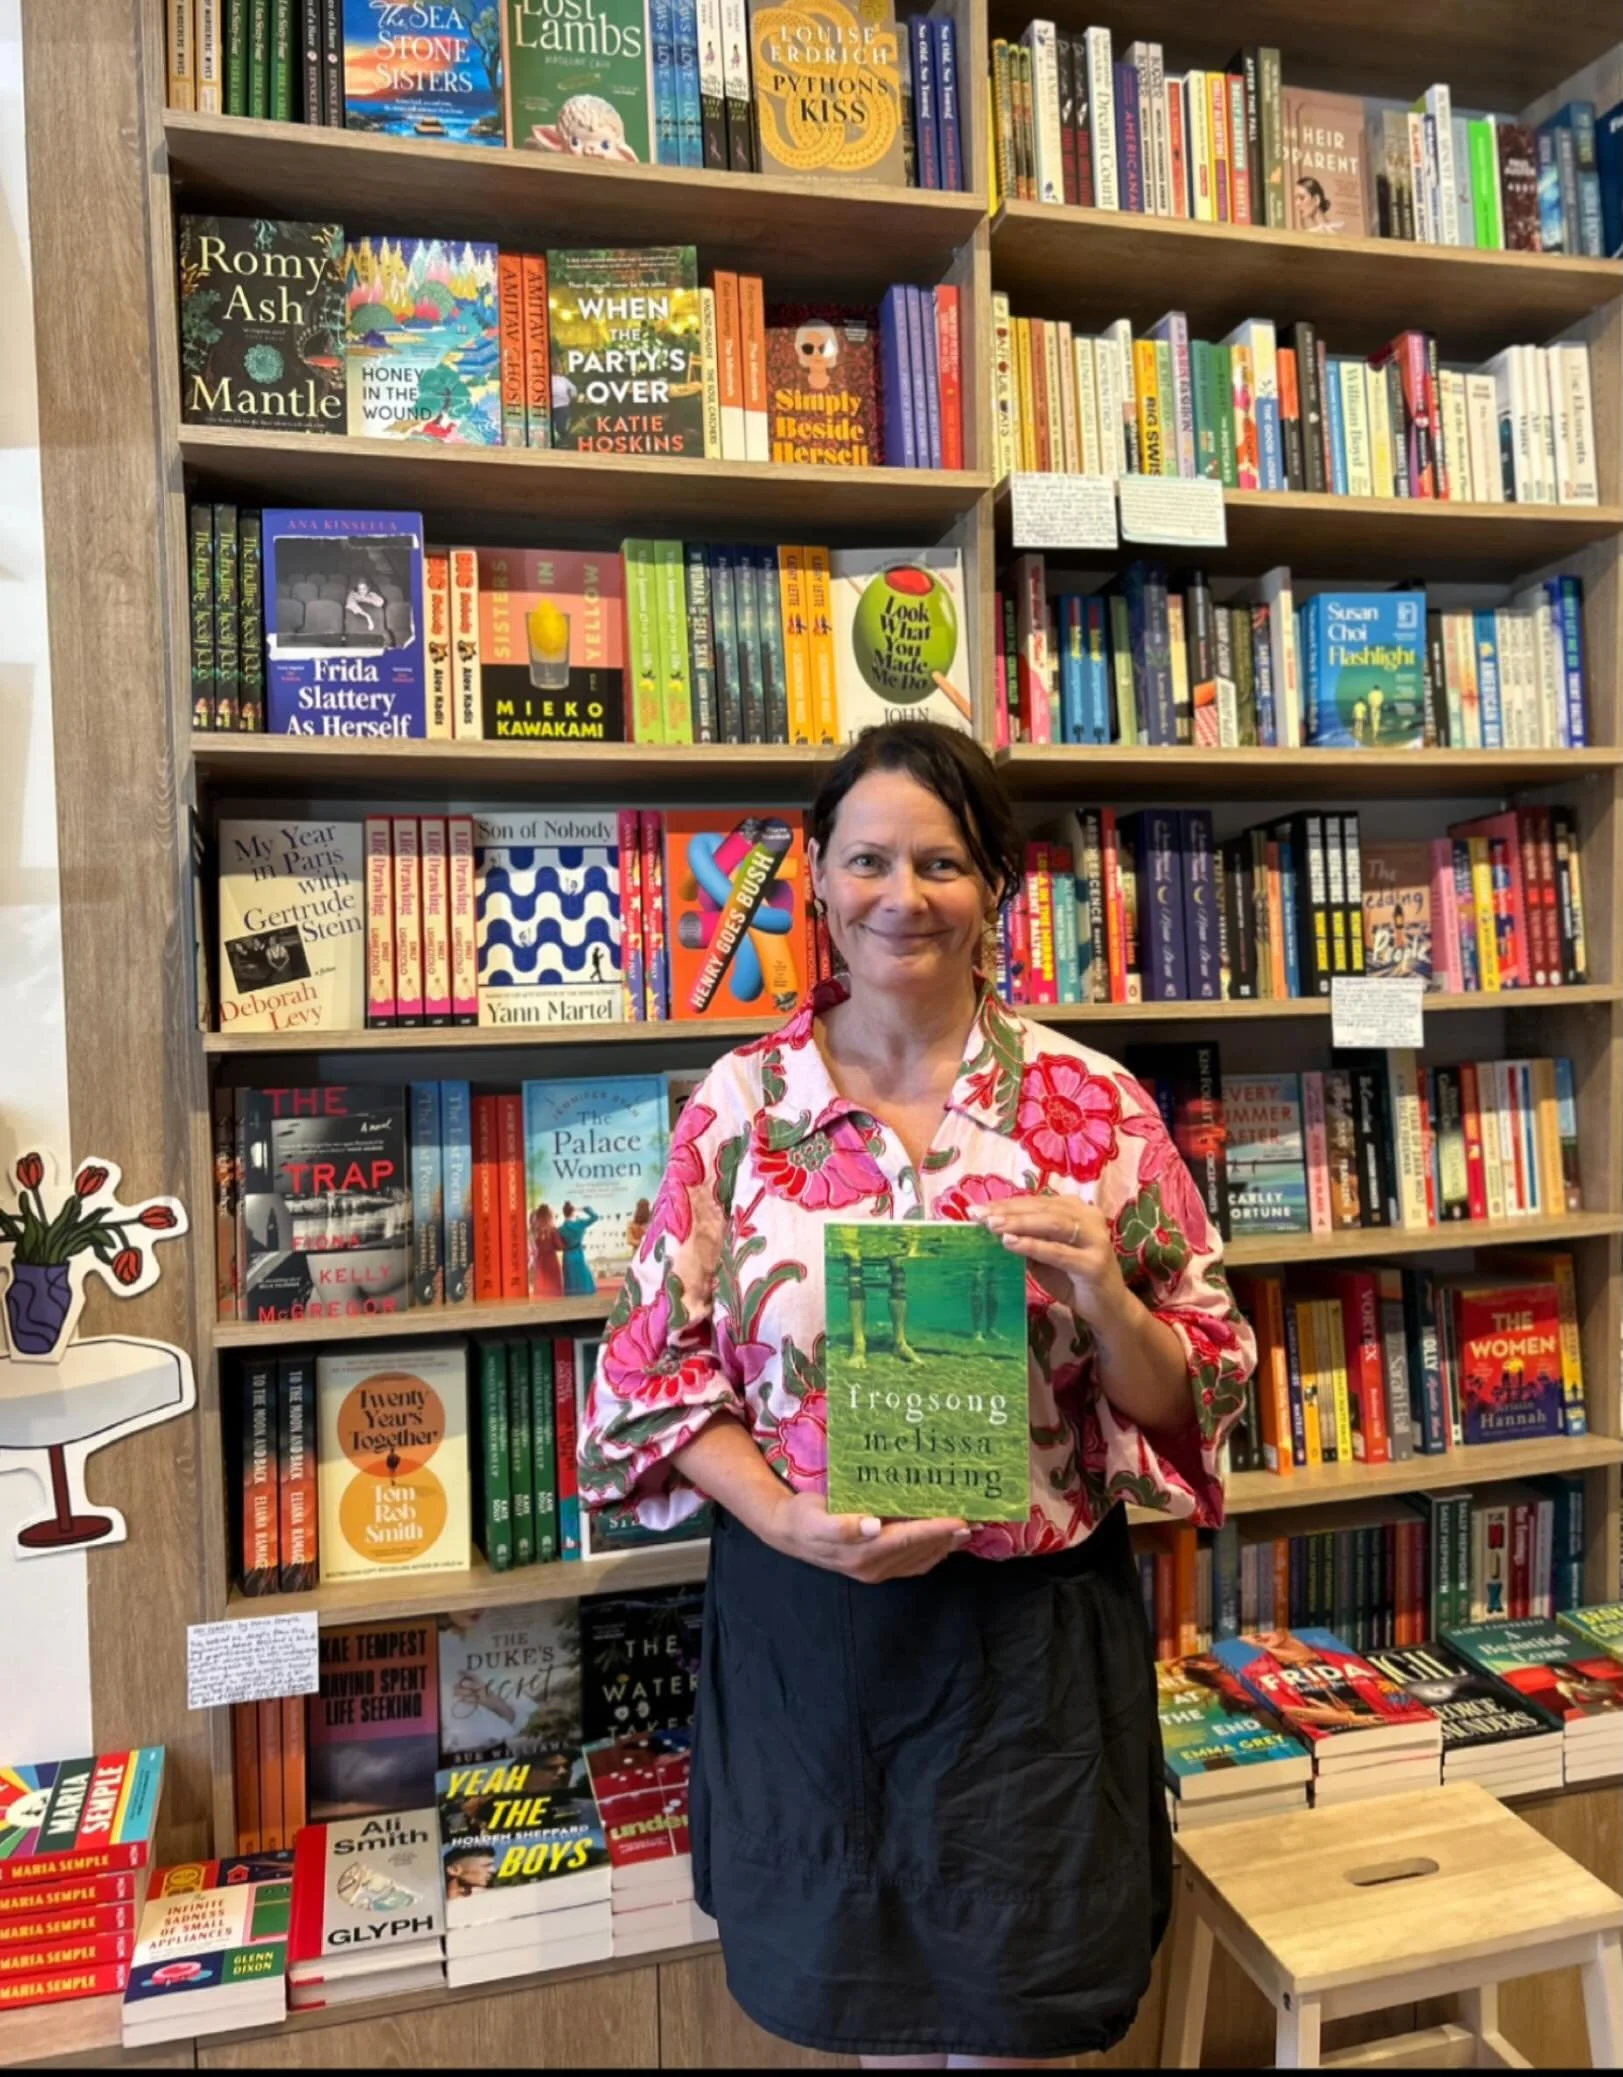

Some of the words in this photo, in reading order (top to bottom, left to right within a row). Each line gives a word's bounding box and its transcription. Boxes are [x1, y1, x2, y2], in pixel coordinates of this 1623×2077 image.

[379, 0, 405, 26] The
[409, 3, 462, 29] SEA
[521, 0, 596, 20] Lost
[515, 6, 642, 58] Lambs
[779, 25, 875, 44] LOUISE
[376, 31, 470, 63] STONE
[770, 45, 889, 65] ERDRICH
[373, 69, 473, 94] SISTERS
[773, 75, 889, 96] PYTHONS
[1245, 58, 1255, 90] AFTER
[800, 98, 866, 123] KISS
[944, 86, 953, 119] Young
[1247, 94, 1256, 114] THE
[1097, 92, 1111, 149] Dream
[1248, 117, 1258, 141] FALL
[1303, 126, 1344, 149] HEIR
[1283, 146, 1359, 175] PPARENT
[1100, 154, 1114, 206] Count
[199, 235, 329, 296] Romy
[223, 285, 305, 325] Ash
[527, 268, 545, 341] AMITAV
[578, 296, 669, 321] WHEN
[611, 328, 641, 341] THE
[569, 348, 686, 373] PARTY'S
[362, 367, 424, 382] HONEY
[532, 348, 548, 419] GHOSH
[190, 375, 342, 420] Mantle
[363, 386, 380, 401] IN
[386, 386, 417, 401] THE
[586, 381, 669, 404] OVER
[775, 389, 861, 418] Simply
[1347, 369, 1362, 426] William
[363, 405, 433, 421] WOUND
[597, 415, 664, 434] KATIE
[1145, 397, 1158, 427] BIG
[1263, 404, 1272, 421] THE
[775, 417, 866, 440] Beside
[1264, 424, 1275, 454] GOOD
[578, 434, 685, 454] HOSKINS
[774, 442, 869, 466] Herself
[1146, 431, 1161, 478] SWIS
[1348, 431, 1365, 467] Boyd
[288, 520, 317, 530] ANA
[323, 520, 398, 531] KINSELLA
[538, 561, 554, 584] IN
[493, 560, 511, 658] SISTERS
[584, 564, 599, 661] YELLOW
[885, 595, 929, 622] Look
[1328, 602, 1379, 622] Susan
[881, 614, 932, 641] What
[1328, 623, 1368, 642] Choi
[885, 636, 921, 657] You
[314, 659, 379, 682] Frida
[872, 649, 928, 674] Made
[1329, 648, 1416, 672] Flashlight
[463, 668, 472, 691] Alex
[872, 665, 897, 688] Me
[901, 671, 927, 690] Do
[299, 686, 396, 717] Slattery
[464, 694, 473, 724] Kadis
[496, 700, 604, 717] MIEKO
[287, 715, 316, 737] As
[322, 714, 412, 737] Herself
[884, 708, 929, 722] JOHN
[497, 722, 603, 738] KAWAKAMI
[235, 836, 274, 860] My
[281, 825, 336, 850] Year
[480, 821, 517, 840] Son
[521, 821, 537, 839] of
[544, 821, 614, 841] Nobody
[251, 860, 276, 882] in
[284, 844, 344, 874] Paris
[297, 869, 350, 896] with
[371, 858, 388, 916] Drawing
[244, 890, 355, 932] Gertrude
[302, 914, 363, 943] Stein
[690, 955, 723, 1009] HENRY
[715, 908, 748, 956] GOES
[742, 852, 774, 908] BUSH
[221, 983, 318, 1023] Deborah
[489, 1003, 541, 1024] Yann
[548, 1001, 613, 1022] Martel
[270, 1004, 322, 1031] Levy
[262, 1086, 349, 1117] THE
[361, 1121, 368, 1132] A
[370, 1119, 392, 1132] novel
[577, 1111, 611, 1126] The
[553, 1129, 641, 1155] Palace
[283, 1160, 395, 1194] TRAP
[553, 1158, 642, 1179] Women
[1230, 1206, 1292, 1219] ORTUNE
[291, 1235, 361, 1251] FIONA
[320, 1265, 393, 1283] KELLY
[257, 1297, 397, 1324] McGREGOR
[1493, 1311, 1534, 1332] THE
[1361, 1290, 1377, 1362] VORTEX
[1470, 1335, 1556, 1359] WOMEN
[1390, 1355, 1406, 1400] Sarah
[289, 1385, 303, 1402] THE
[356, 1389, 427, 1410] Twenty
[849, 1383, 1007, 1425] frogsong
[289, 1405, 303, 1432] MOON
[364, 1410, 423, 1429] Years
[1393, 1403, 1410, 1434] Hall
[1481, 1411, 1547, 1429] Hannah
[350, 1429, 439, 1454] Together
[864, 1428, 992, 1453] melissa
[290, 1455, 303, 1480] BACK
[857, 1462, 1003, 1499] manning
[375, 1485, 416, 1503] Tom
[375, 1503, 416, 1523] Rob
[365, 1522, 423, 1544] Smith
[356, 1630, 426, 1658] TEMPEST
[493, 1632, 528, 1648] THE
[625, 1635, 677, 1658] THE
[466, 1646, 555, 1671] DUKE'S
[1367, 1650, 1468, 1685] IGIL
[380, 1665, 428, 1693] SPENT
[602, 1673, 699, 1703] WATER
[1260, 1663, 1373, 1690] FRIDA
[326, 1699, 354, 1726] LIFE
[361, 1694, 423, 1721] SEEKING
[1174, 1691, 1200, 1704] AT
[1430, 1697, 1507, 1720] EORGE
[1159, 1709, 1205, 1725] THE
[1211, 1719, 1261, 1736] END
[1181, 1744, 1236, 1761] EMMA
[1238, 1732, 1285, 1749] GREY
[446, 1764, 531, 1799] YEAH
[47, 1772, 91, 1835] MARIA
[81, 1764, 124, 1834] SEMPLE
[487, 1796, 551, 1829] THE
[361, 1816, 401, 1836] Ali
[451, 1832, 511, 1846] HOLDEN
[516, 1824, 589, 1840] SHEPPARD
[333, 1829, 429, 1855] Smith
[12, 1859, 56, 1878] MARIA
[59, 1854, 109, 1873] SEMPLE
[497, 1838, 593, 1878] BOYS
[163, 1908, 225, 1926] SADNESS
[167, 1900, 224, 1916] INFINITE
[149, 1927, 233, 1950] APPLIANCES
[160, 1926, 177, 1936] OF
[182, 1920, 224, 1934] SMALL
[327, 1915, 433, 1945] GLYPH
[233, 1962, 272, 1975] DIXON
[234, 1951, 274, 1965] GLENN
